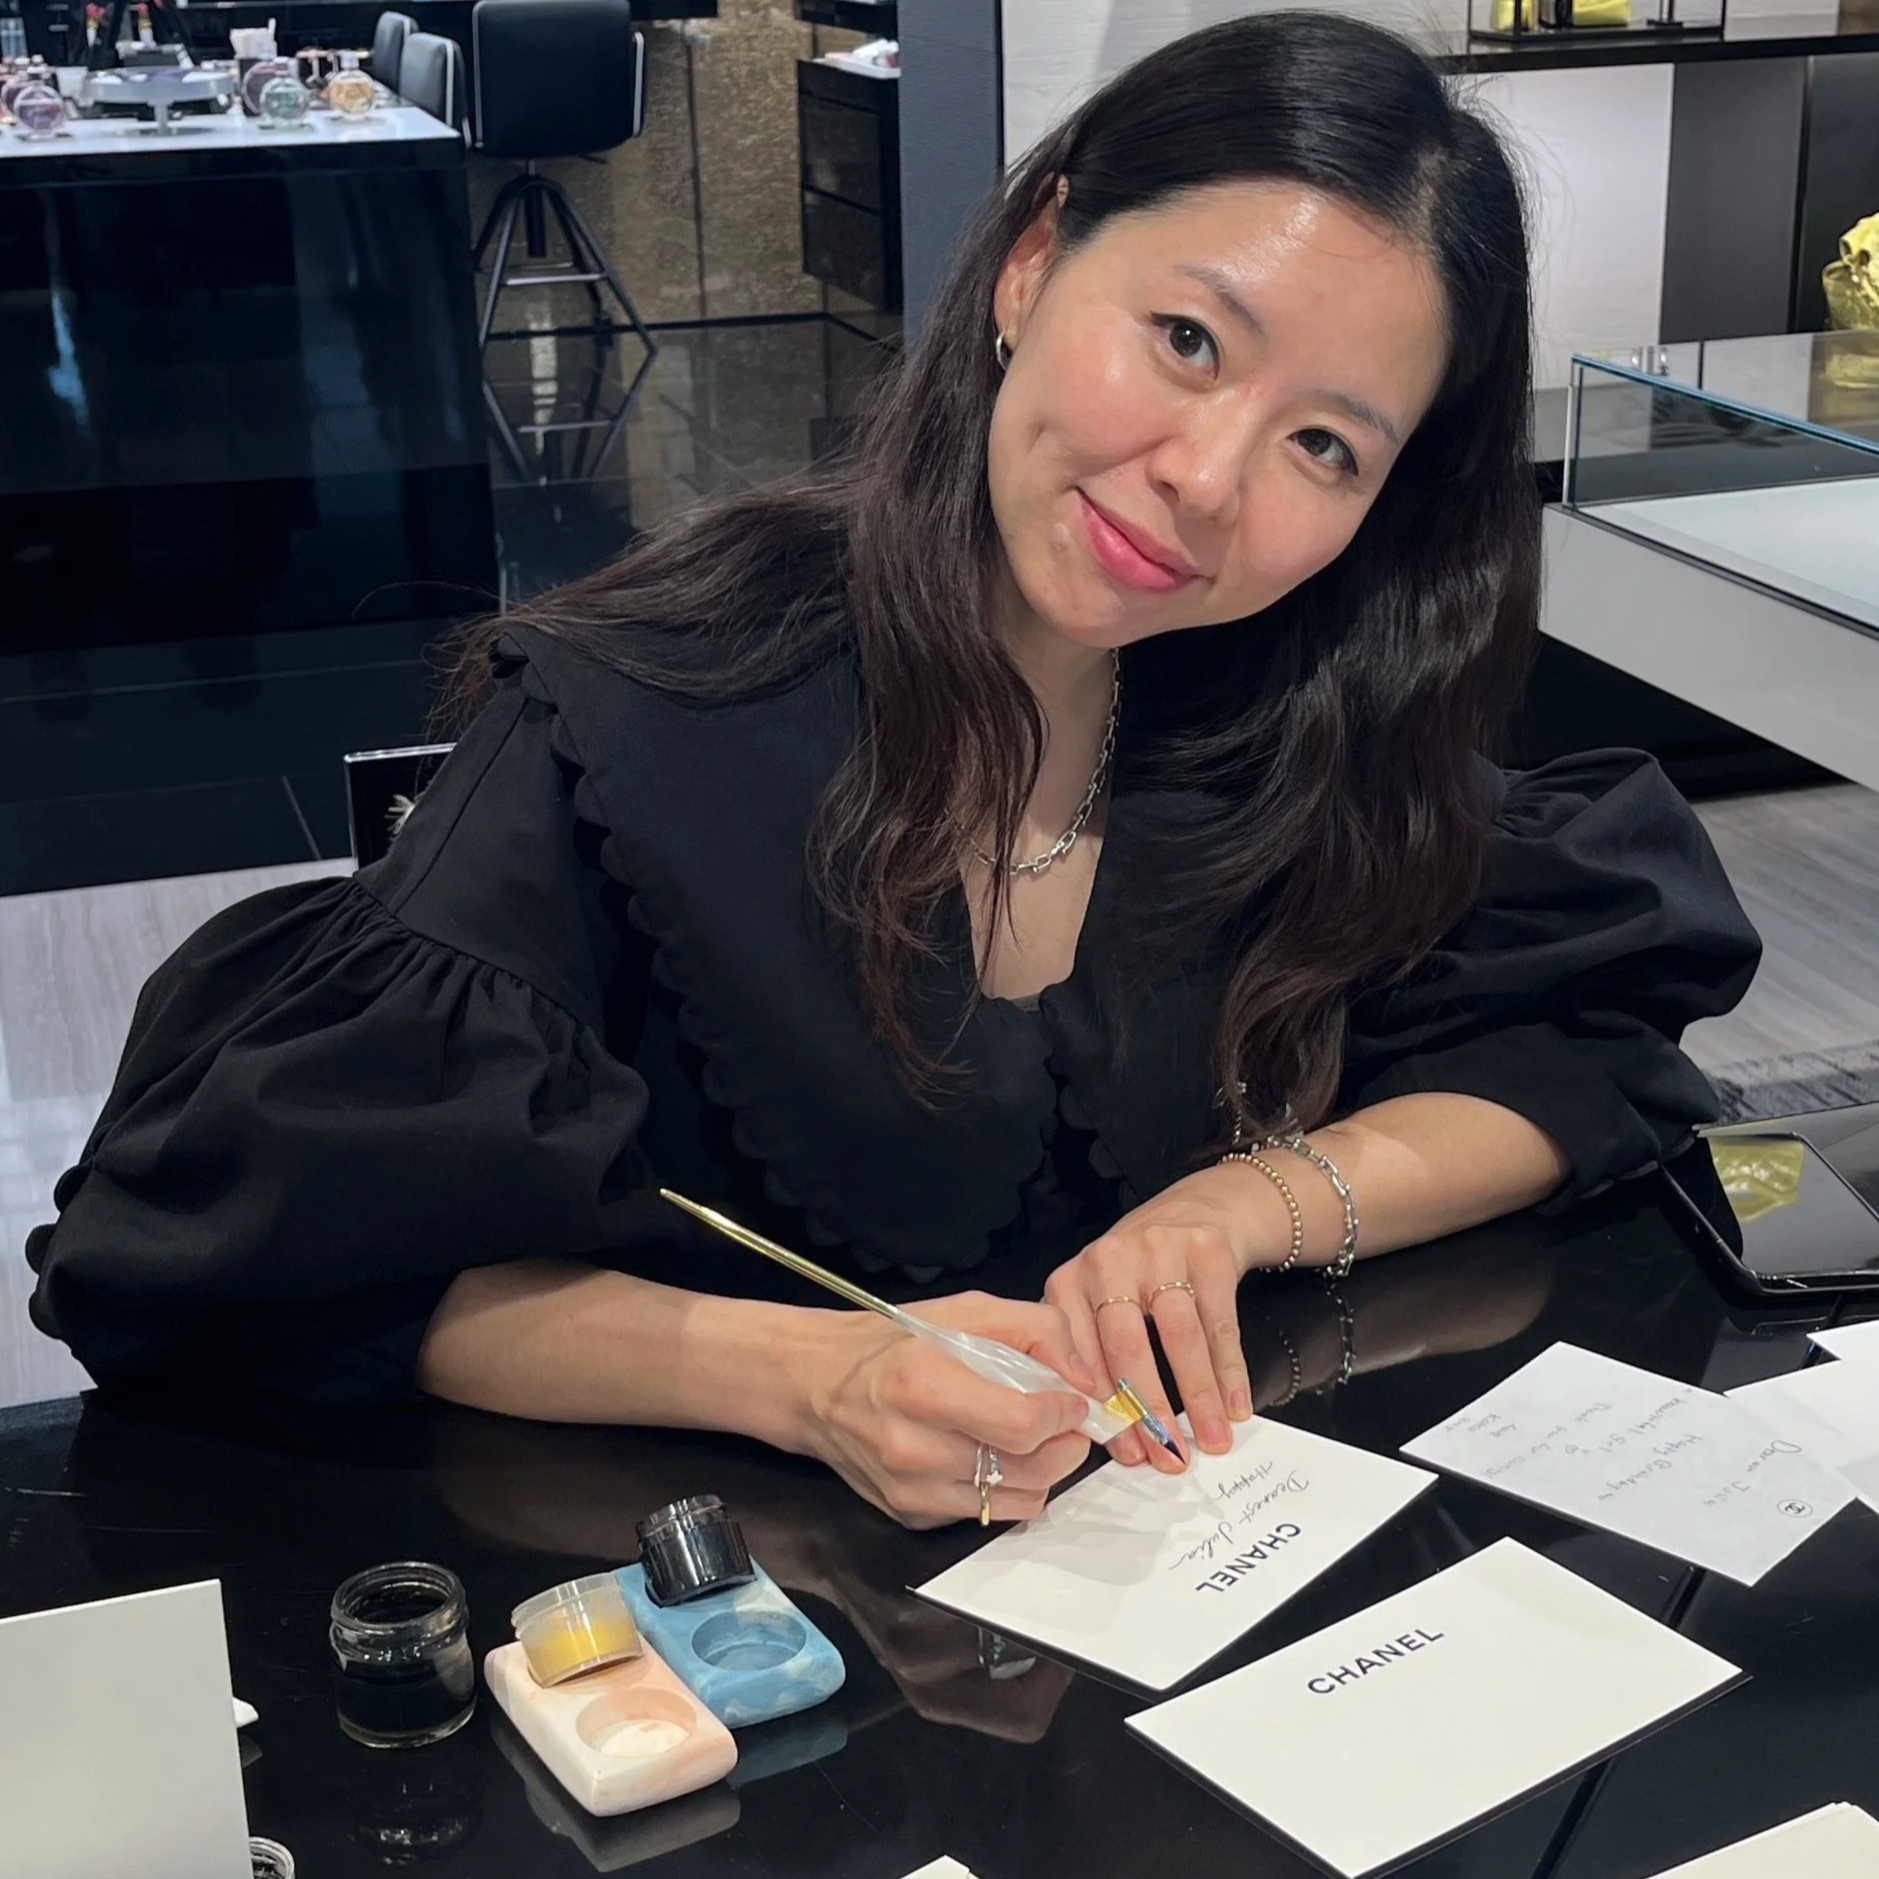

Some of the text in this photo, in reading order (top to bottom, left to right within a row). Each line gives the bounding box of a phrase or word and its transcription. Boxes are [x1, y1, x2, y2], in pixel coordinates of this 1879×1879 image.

[1216, 1461, 1273, 1500] Happy
[1168, 1469, 1309, 1570] Dearest Julia
[1195, 1523, 1301, 1592] CHANEL
[1307, 1628, 1444, 1695] CHANEL
